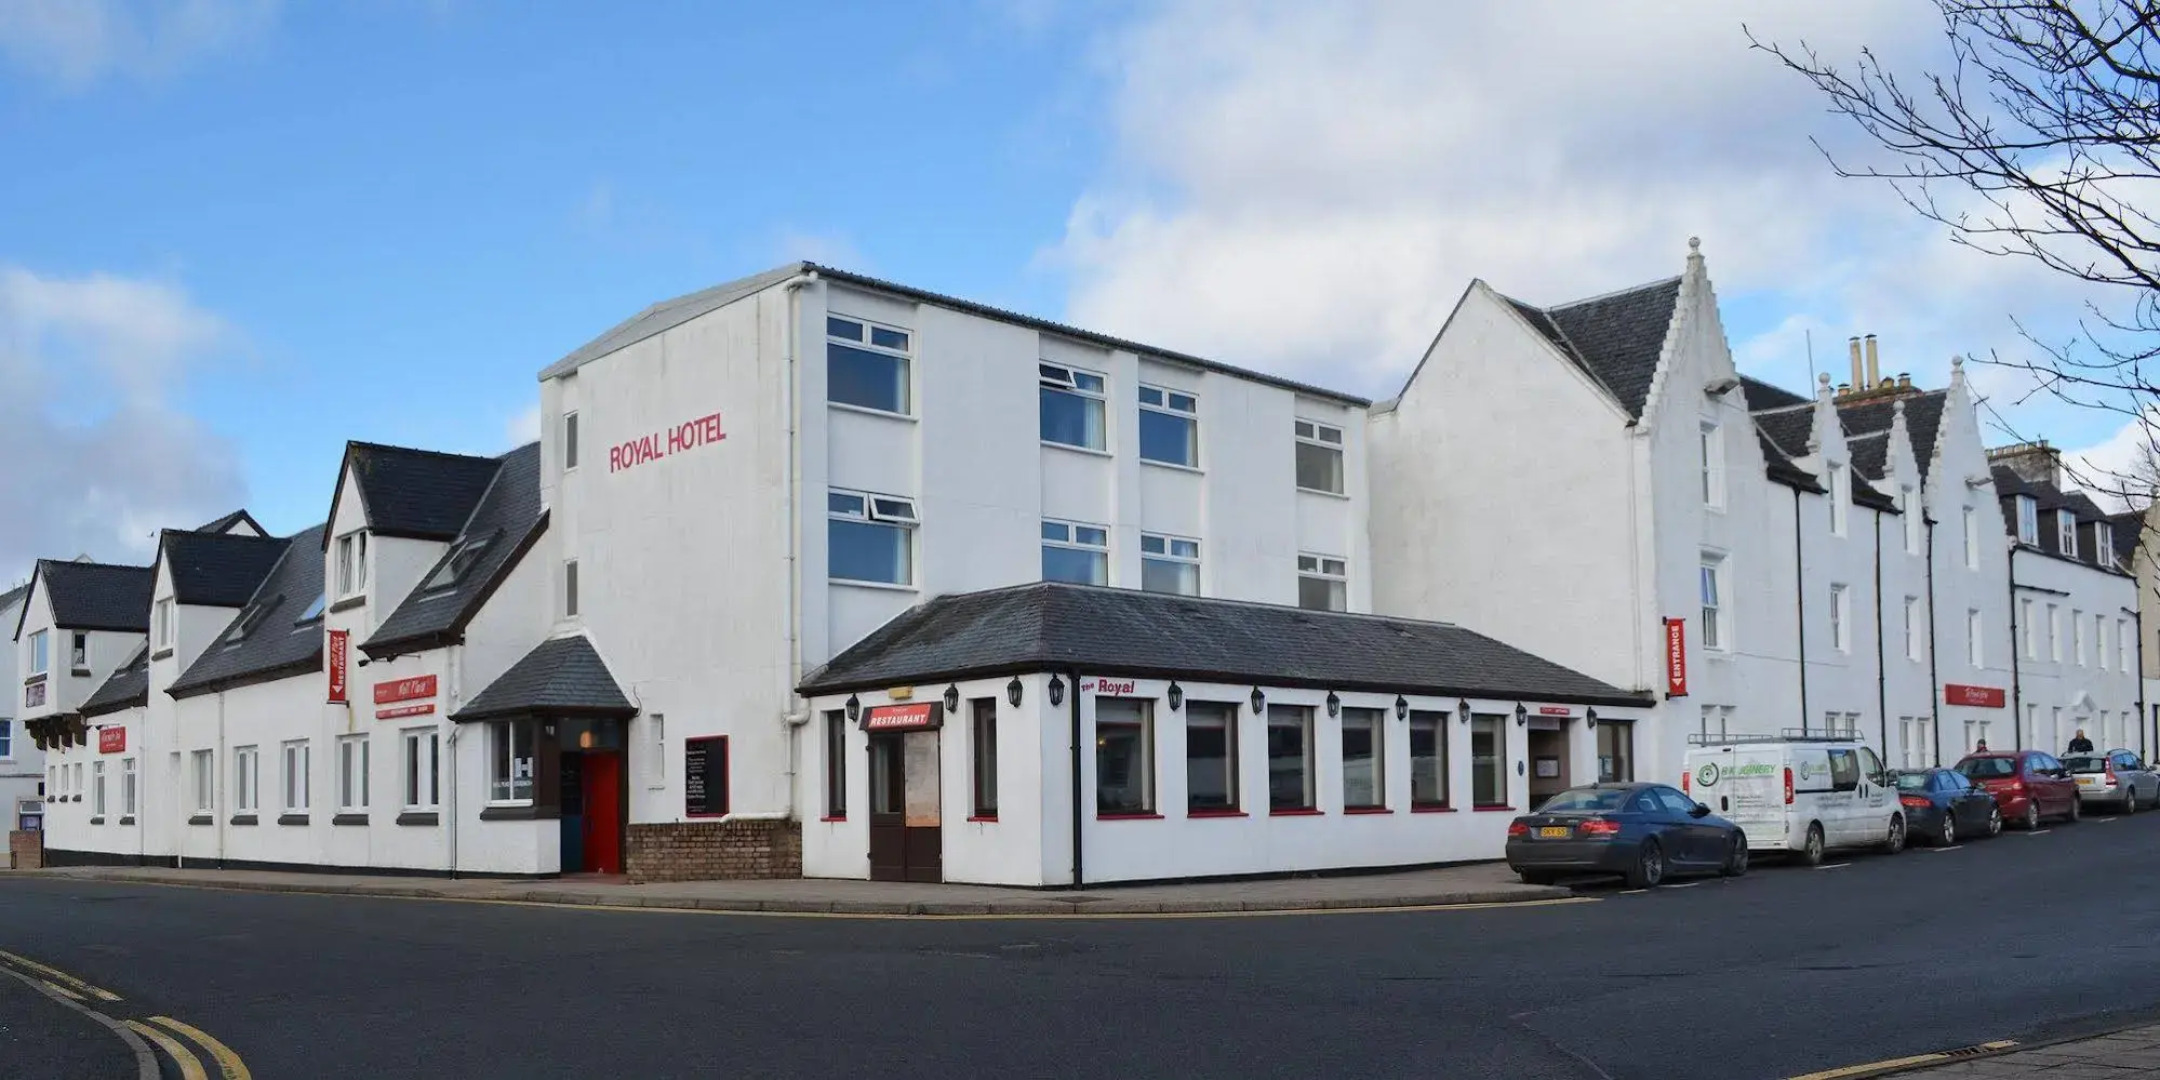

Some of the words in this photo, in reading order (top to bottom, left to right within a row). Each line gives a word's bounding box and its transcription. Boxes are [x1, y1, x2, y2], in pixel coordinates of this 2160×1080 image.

[610, 433, 664, 473] ROYAL
[668, 413, 727, 455] HOTEL
[1671, 625, 1681, 677] ENTRANCE
[1098, 679, 1135, 696] Royal
[870, 714, 926, 726] RESTAURANT
